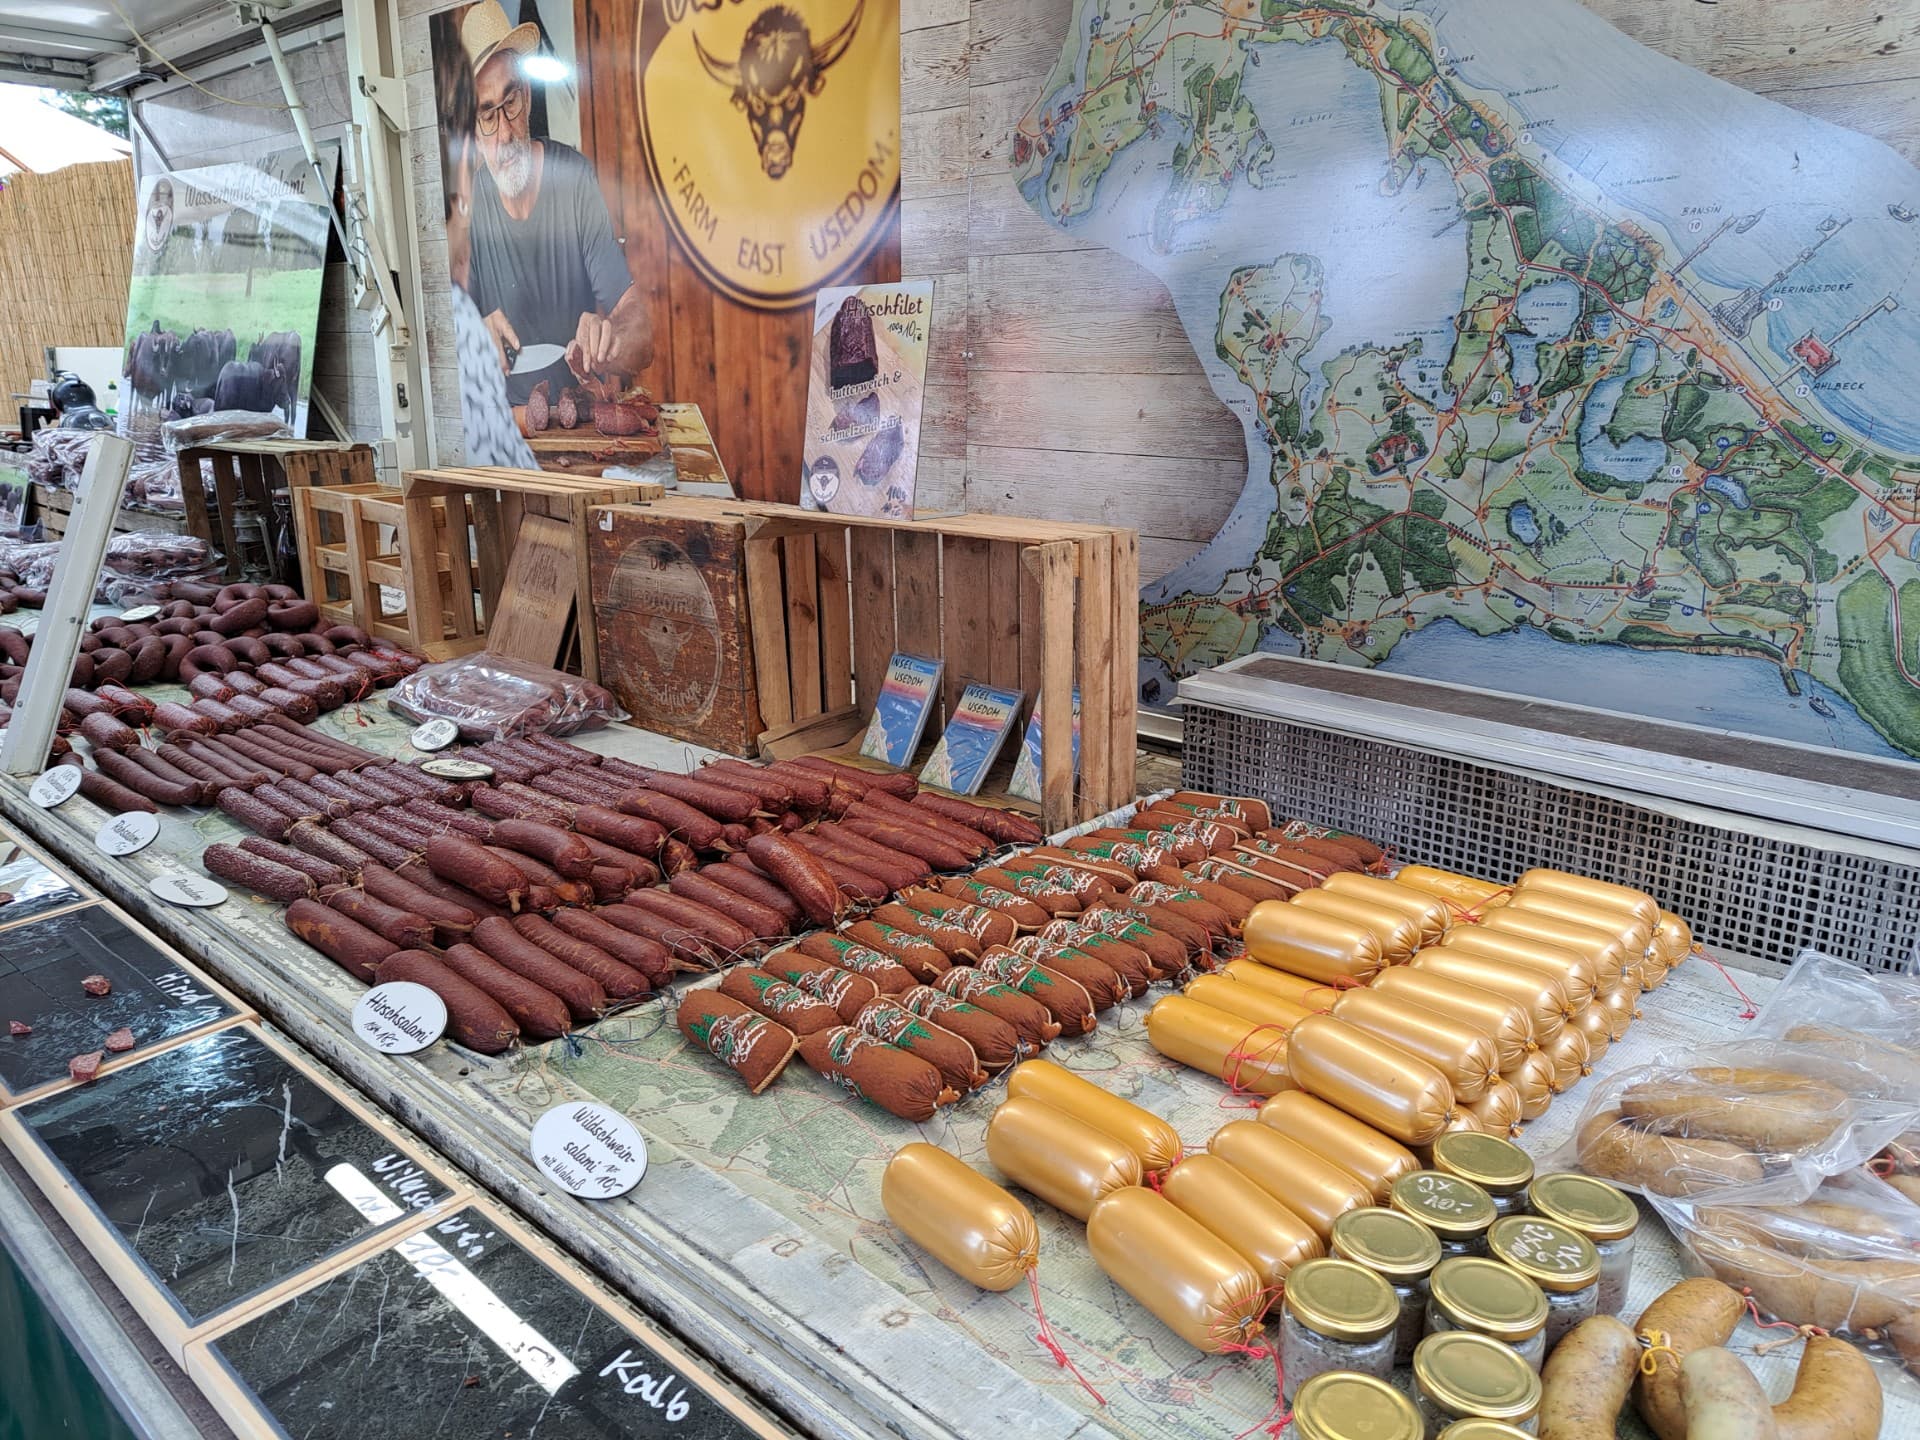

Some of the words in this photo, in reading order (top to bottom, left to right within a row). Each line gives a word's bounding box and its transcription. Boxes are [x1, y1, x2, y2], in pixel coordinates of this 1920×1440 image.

[673, 163, 718, 243] FARM
[809, 141, 893, 262] USEDOM
[1689, 221, 1700, 231] 10
[737, 237, 785, 277] EAST
[1773, 282, 1854, 295] HERINGSDORF
[846, 293, 924, 318] Hirschfilet
[829, 375, 890, 401] butterweich
[893, 370, 902, 383] &
[1811, 381, 1865, 391] AHLBECK
[892, 656, 913, 670] INSEL
[895, 671, 923, 687] USEDOM
[966, 687, 990, 700] INSEL
[968, 702, 1001, 717] USEDOM
[366, 992, 434, 1044] Hirschsalami
[572, 1106, 636, 1163] Wildschwein-
[542, 1154, 557, 1168] mit
[552, 1161, 587, 1191] Walnuß
[563, 1141, 603, 1174] salami
[598, 1349, 690, 1422] Kalb
